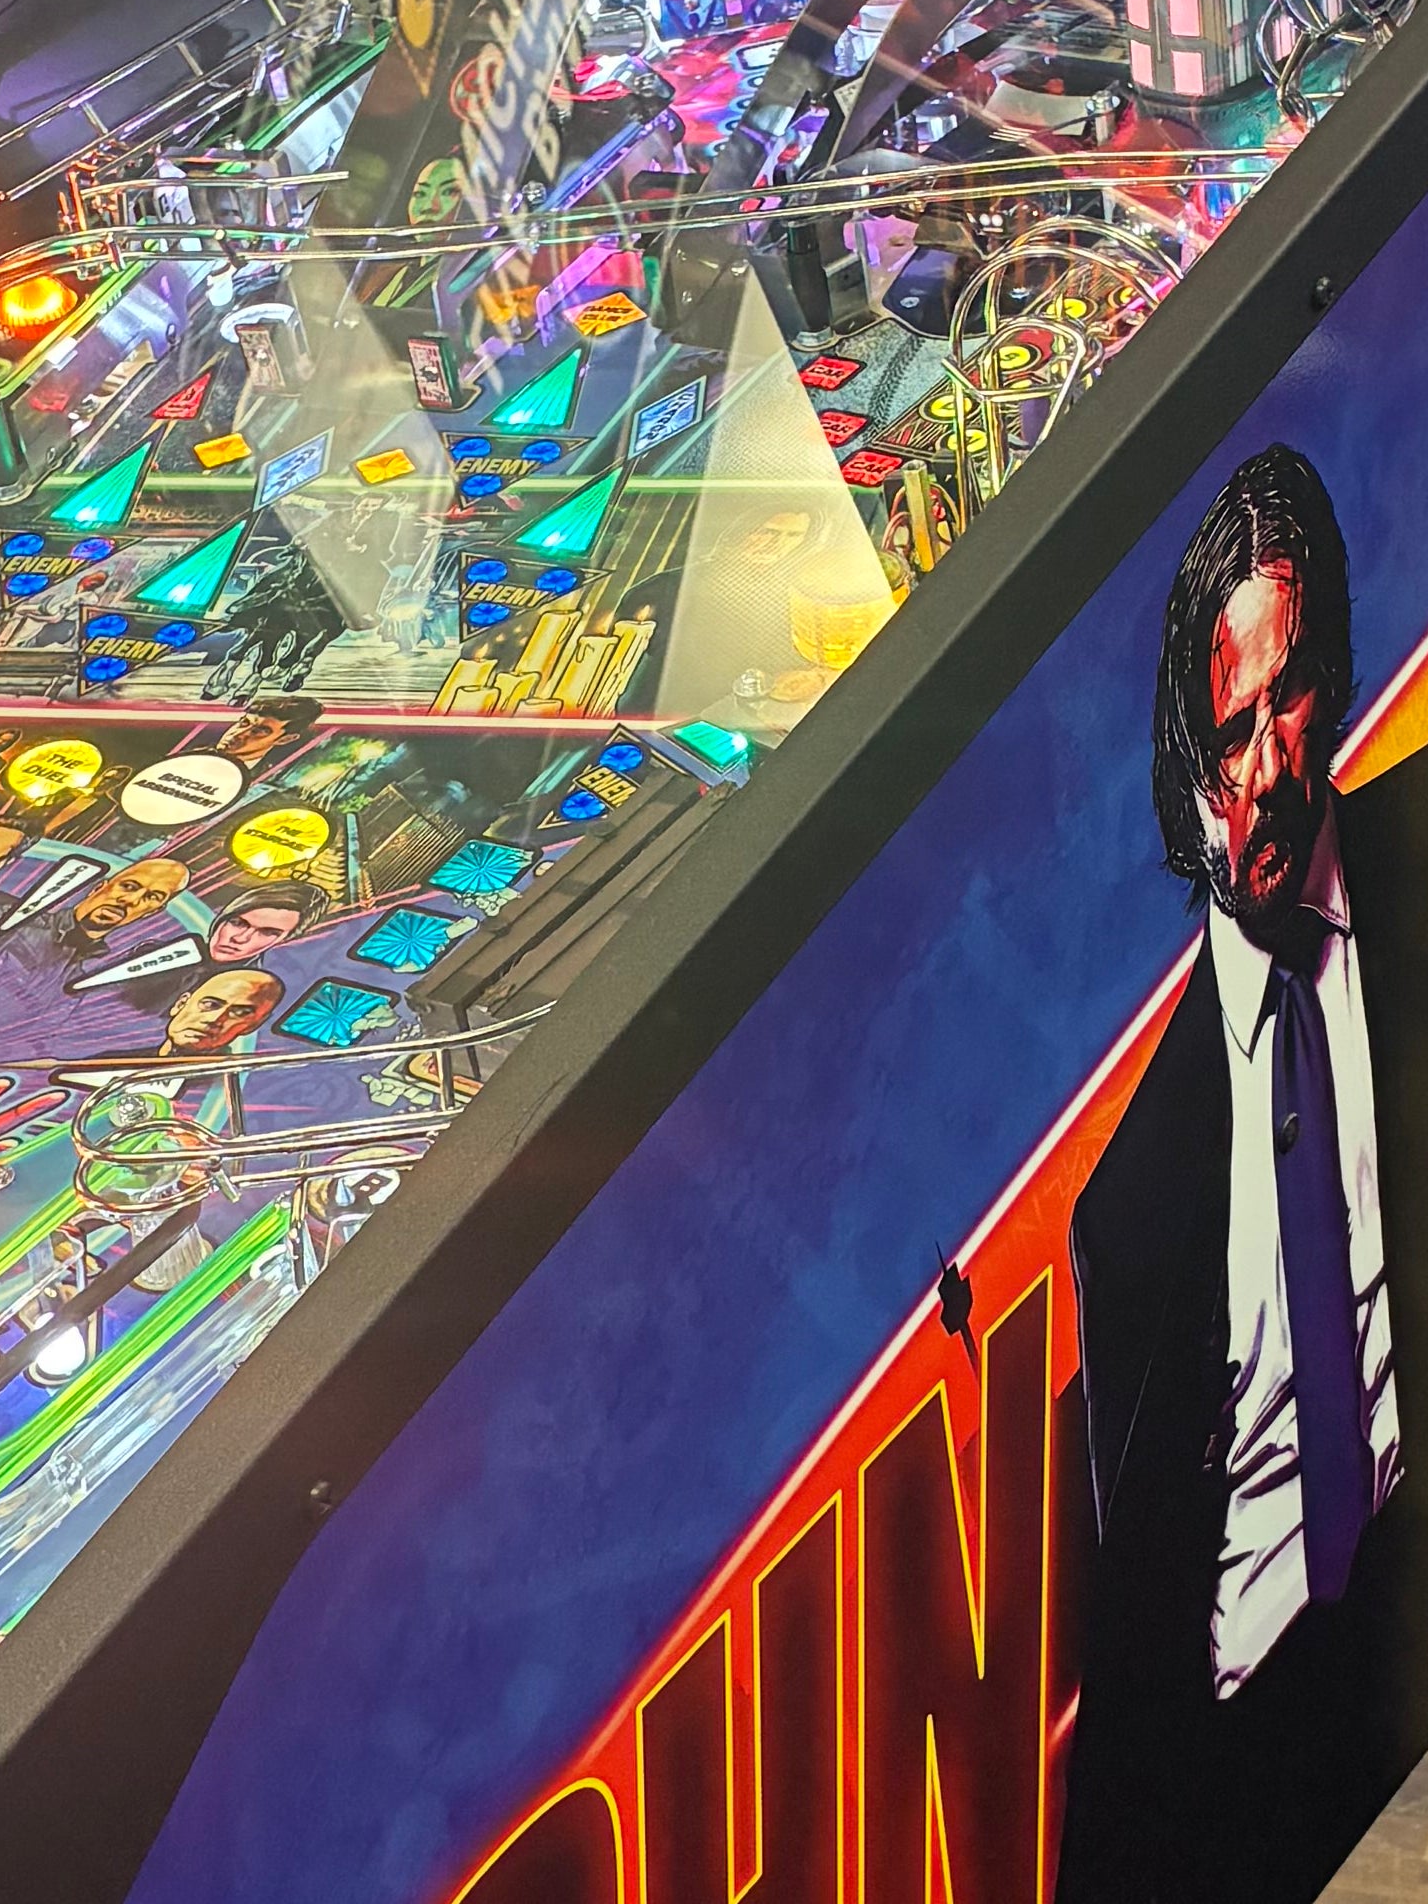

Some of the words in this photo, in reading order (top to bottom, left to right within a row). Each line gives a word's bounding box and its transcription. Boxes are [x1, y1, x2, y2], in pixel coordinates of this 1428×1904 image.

[809, 364, 844, 379] CAR
[456, 457, 537, 476] ENEMY
[850, 460, 886, 474] CAR
[4, 555, 85, 576] ENEMY
[465, 582, 549, 608] ENEMY
[86, 637, 169, 661] ENEMY
[46, 752, 80, 770] THE
[22, 765, 68, 784] DUEL
[158, 772, 220, 795] SPECIAL
[133, 779, 223, 809] ASSIGNMENT
[276, 825, 304, 838] THE
